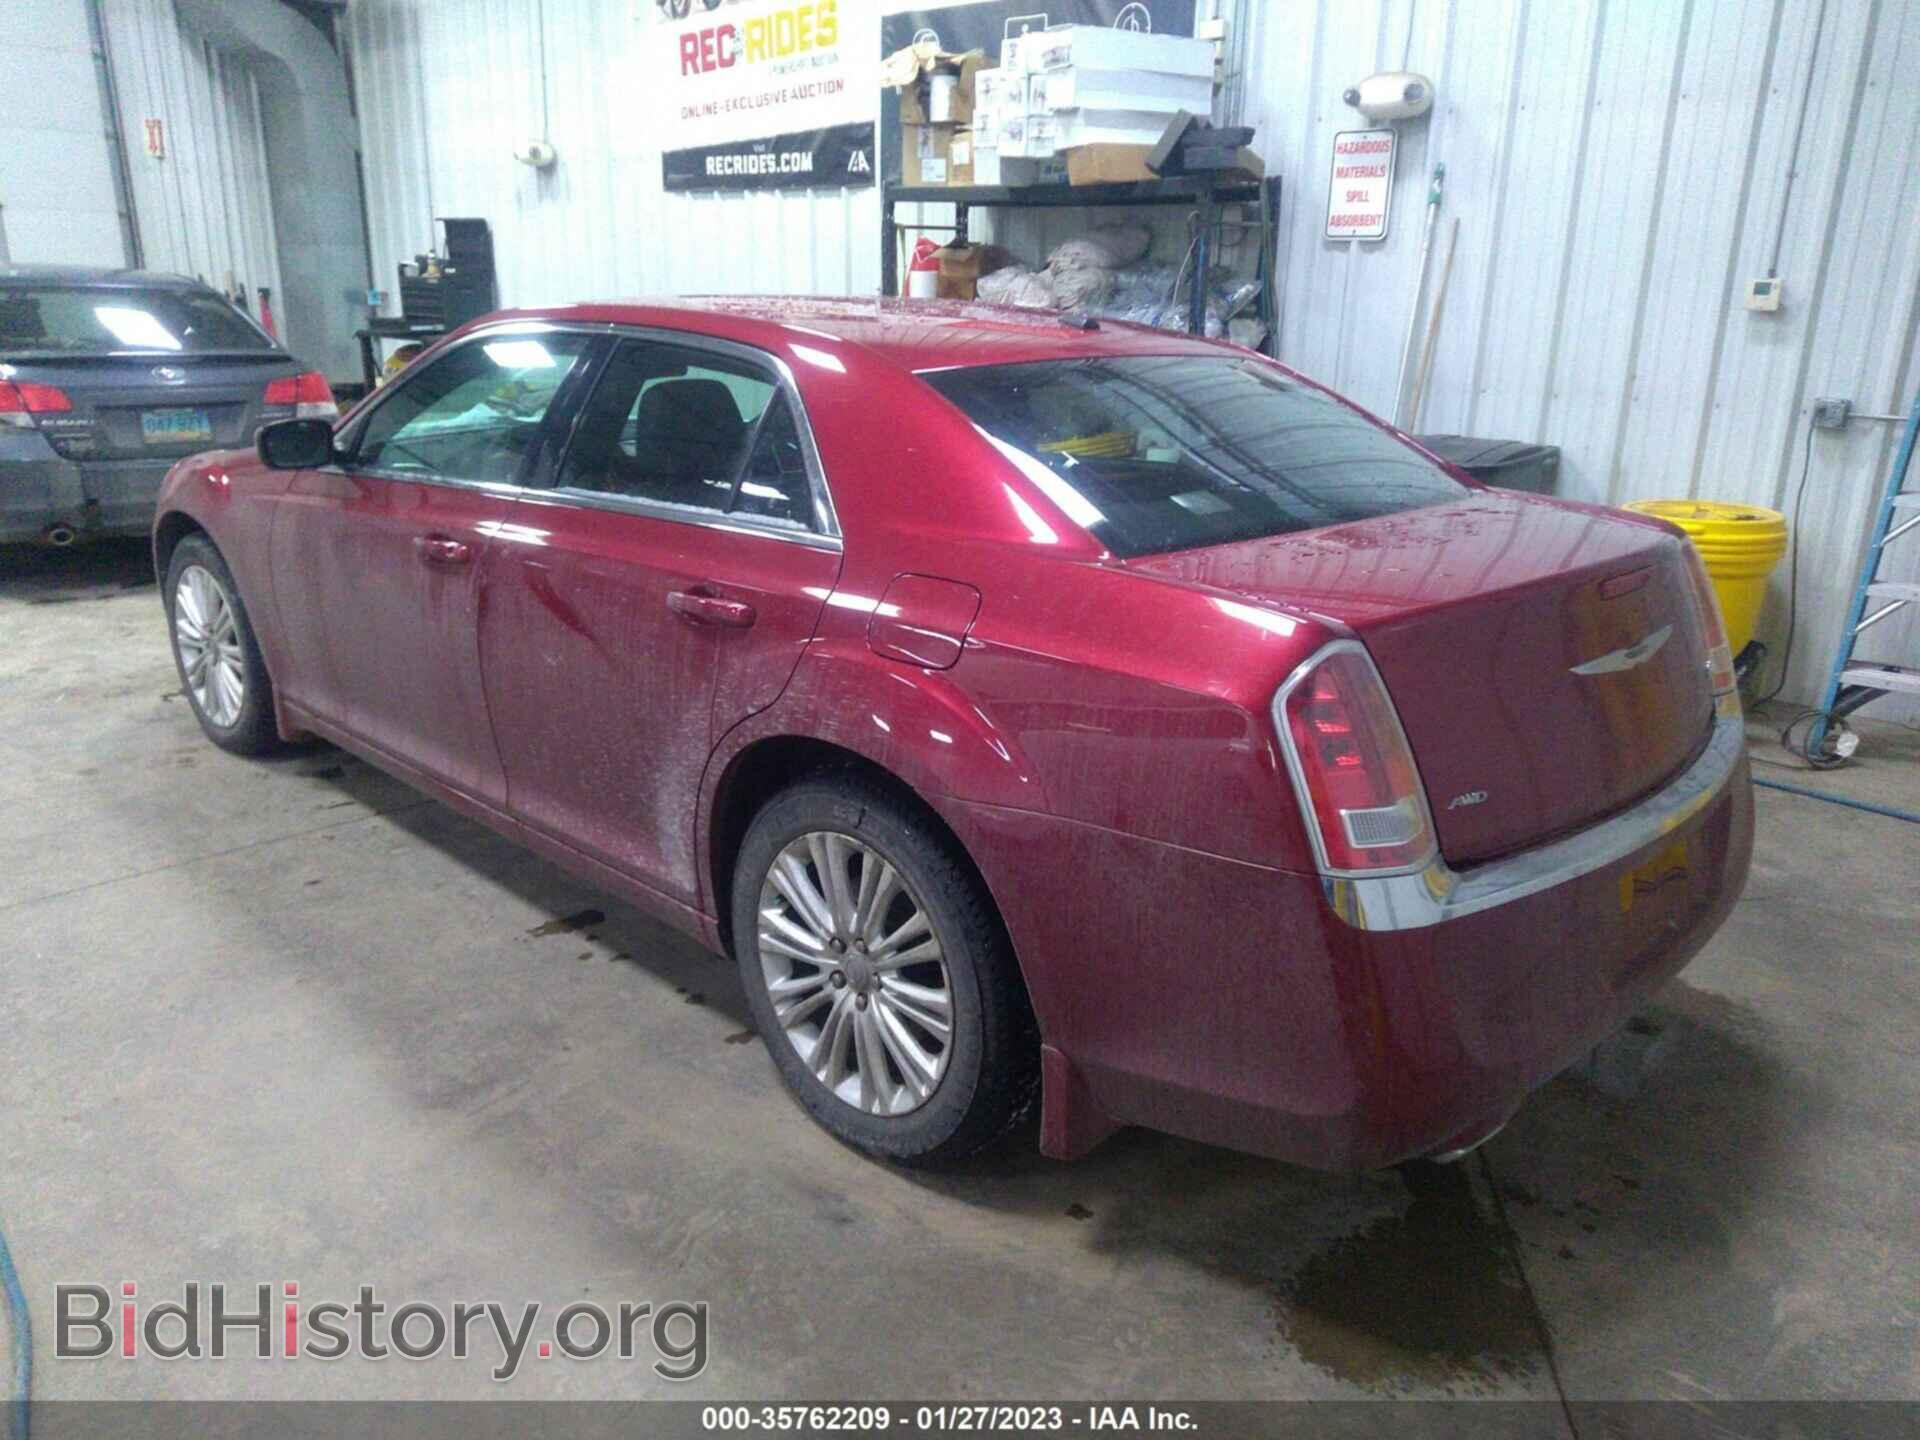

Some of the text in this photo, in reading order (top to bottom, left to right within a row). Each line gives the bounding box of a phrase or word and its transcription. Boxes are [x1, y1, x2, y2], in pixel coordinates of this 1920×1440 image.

[680, 24, 736, 76] REC
[745, 0, 838, 64] RIDES
[681, 78, 844, 119] ONLINE-EXCLUSIVE AUCTION
[1336, 140, 1392, 154] HAZARDOUS
[705, 152, 813, 175] RECRIDES.COM
[1336, 165, 1386, 178] MATERIALS
[1346, 190, 1369, 202] SPILL
[1329, 214, 1382, 226] ABSORBENT
